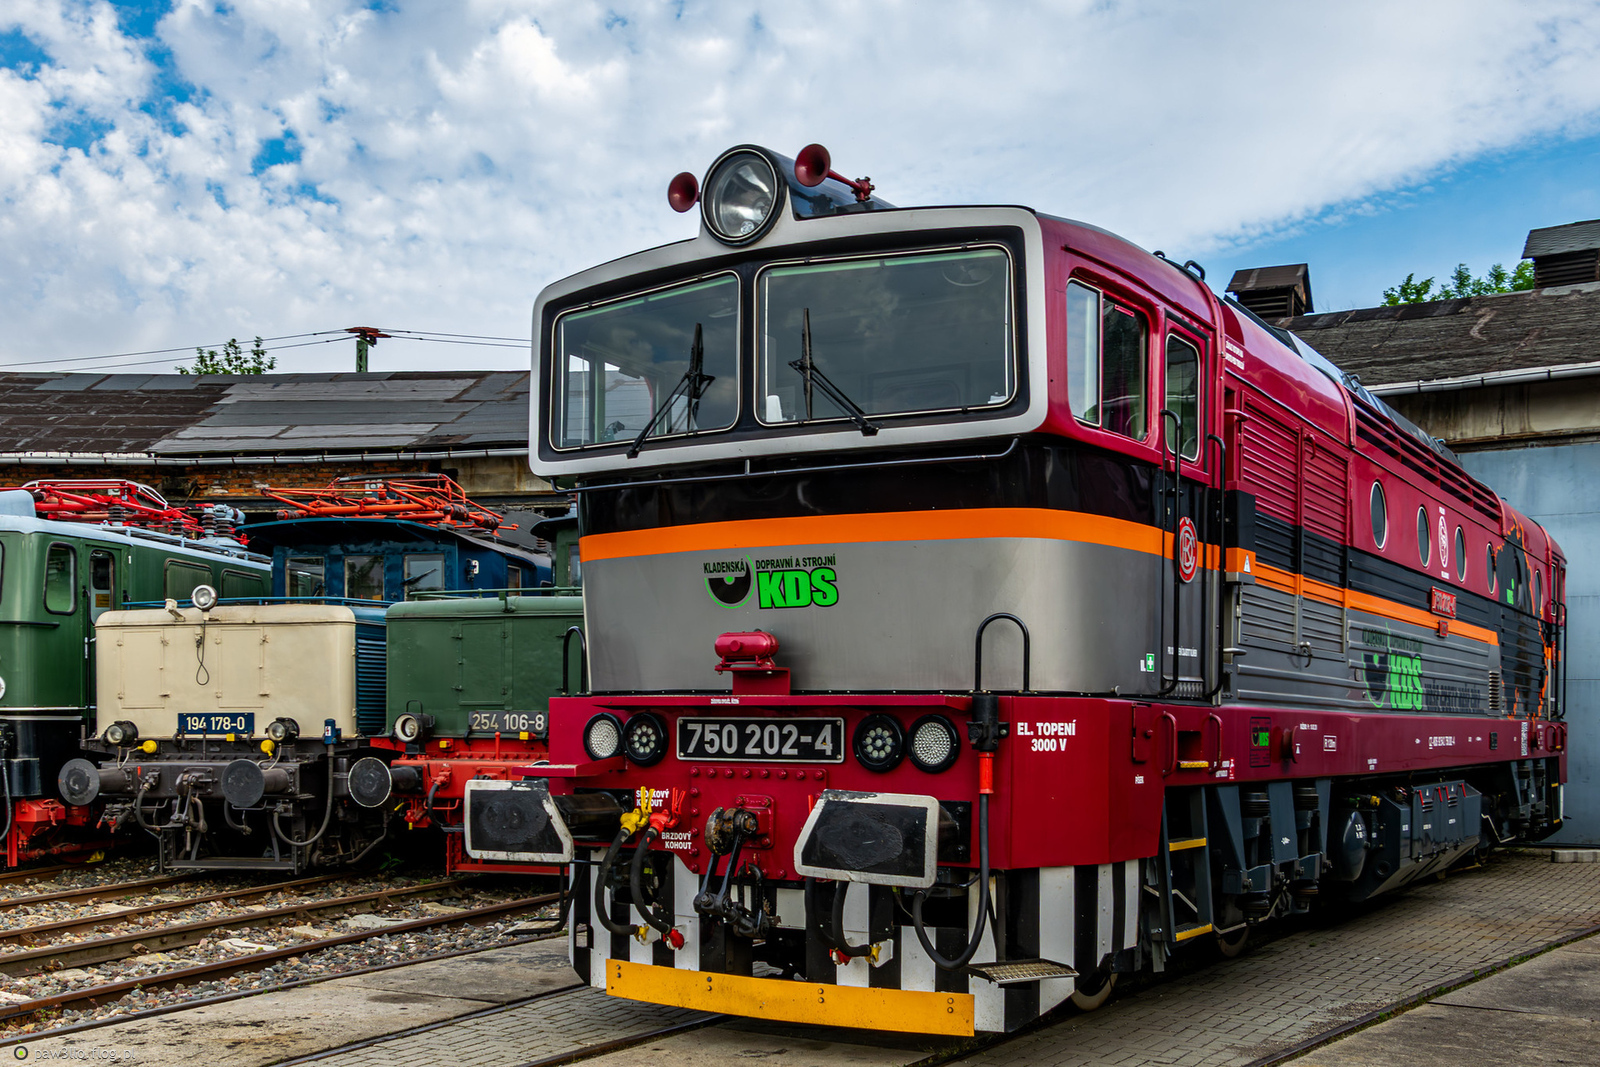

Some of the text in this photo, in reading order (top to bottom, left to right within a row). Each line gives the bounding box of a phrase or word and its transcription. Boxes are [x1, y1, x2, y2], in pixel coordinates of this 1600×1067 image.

[703, 558, 746, 574] KLADENSKÁ
[755, 553, 837, 569] DOPRAVNÍ A STROJNÍ
[757, 567, 839, 609] KDS
[1390, 652, 1423, 710] KDS
[186, 716, 246, 731] 194 178-0
[472, 713, 545, 731] 254 106-8
[1017, 719, 1077, 736] EL. TOPENÍ
[686, 723, 834, 756] 750 202-4
[1031, 738, 1067, 752] 3000 V
[636, 799, 663, 807] KOUT
[661, 831, 692, 841] BRZDOVÝ
[664, 841, 692, 849] KOHOUT
